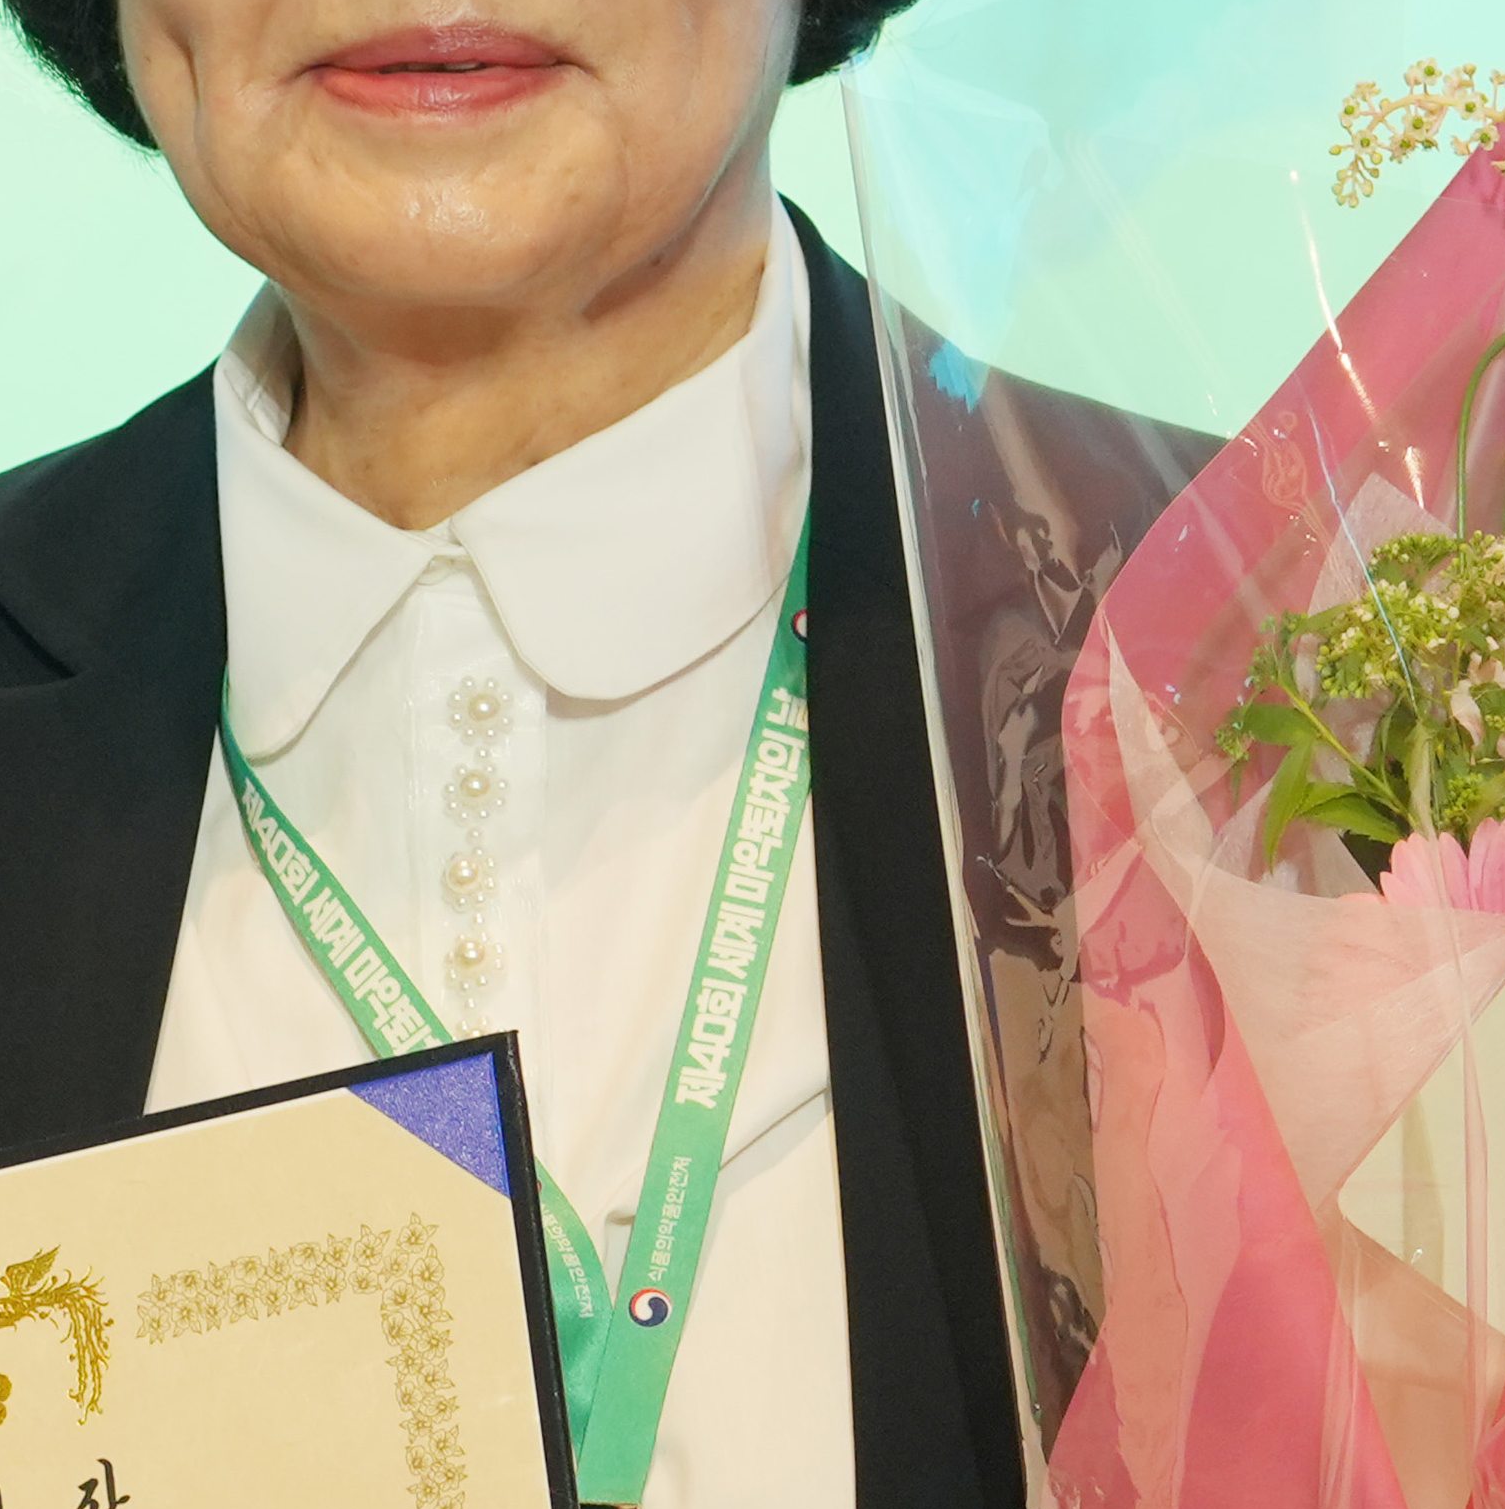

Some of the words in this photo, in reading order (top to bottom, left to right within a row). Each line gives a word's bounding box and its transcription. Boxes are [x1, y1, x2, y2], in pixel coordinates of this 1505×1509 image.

[725, 727, 806, 904] 마약퇴치의
[242, 777, 321, 906] 제40회
[303, 887, 366, 969] 세계
[343, 946, 444, 1057] 마약퇴
[707, 900, 766, 980] 세계
[674, 976, 748, 1110] 제40회
[647, 1156, 692, 1282] 식품의약품안전처
